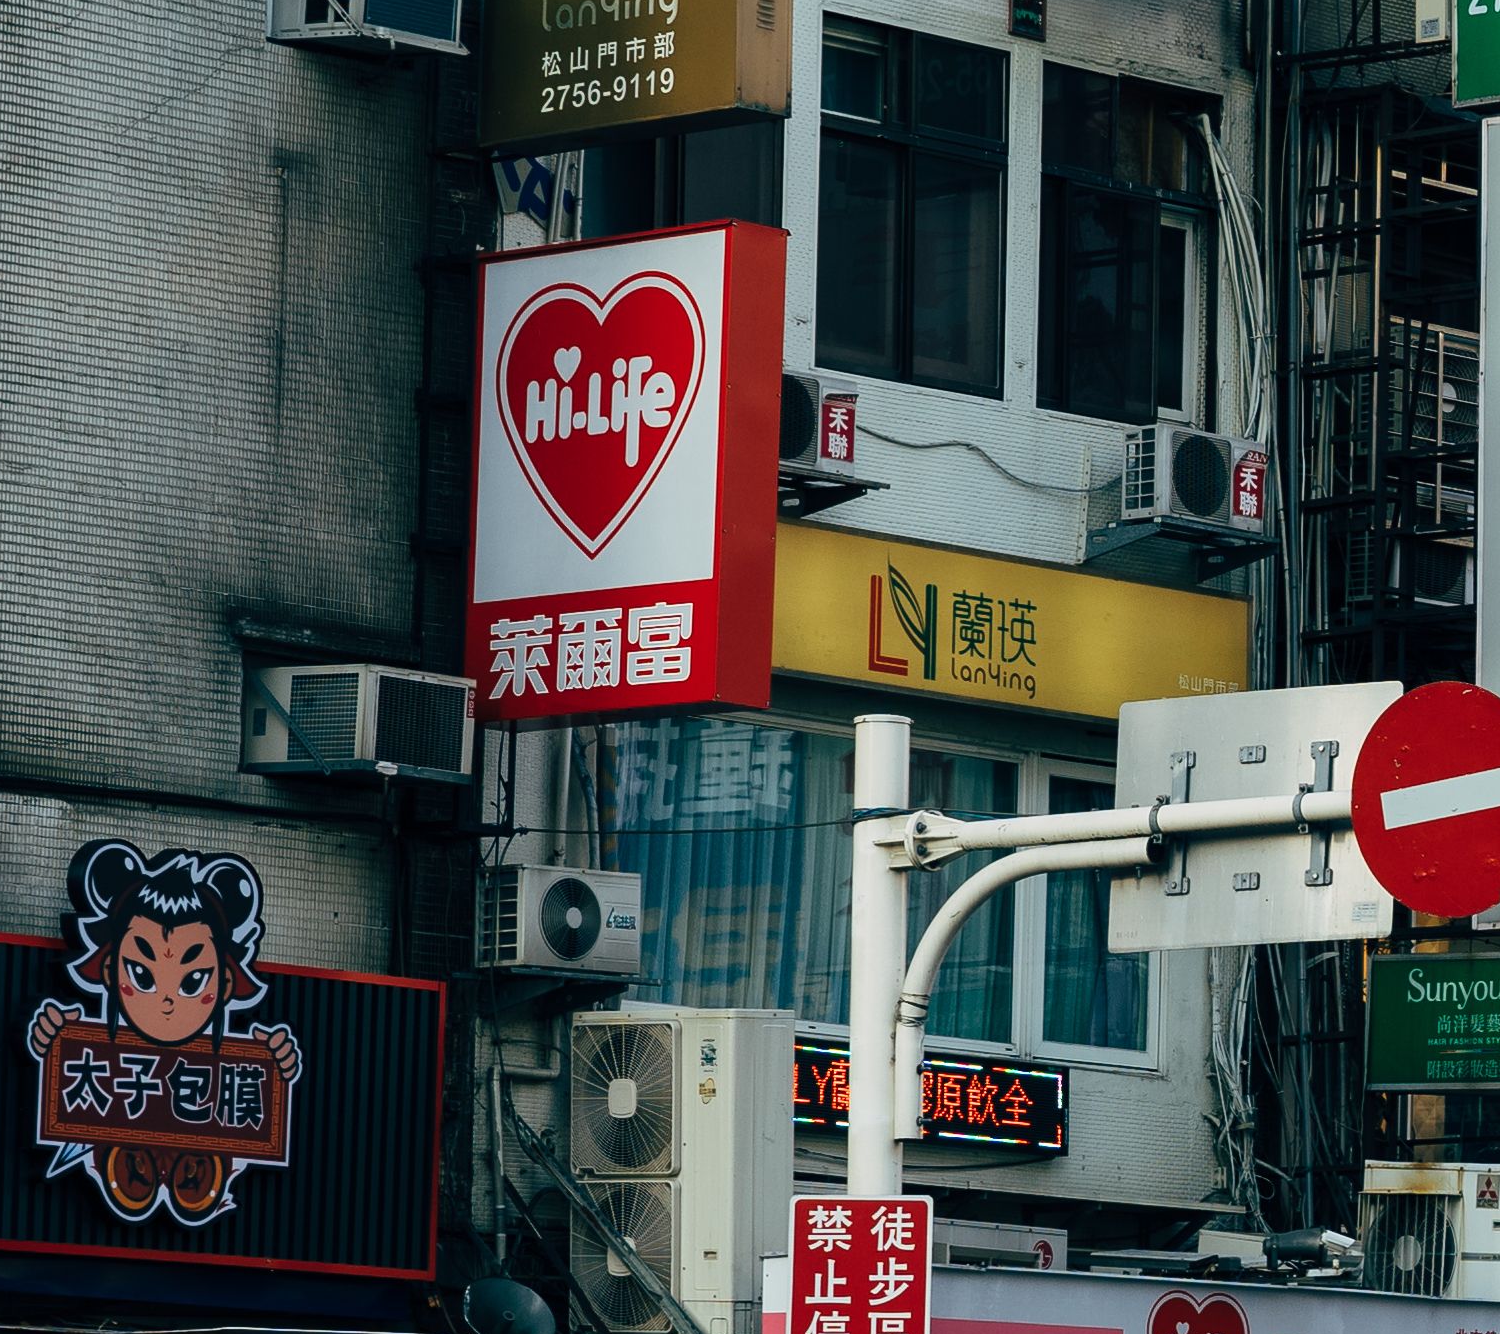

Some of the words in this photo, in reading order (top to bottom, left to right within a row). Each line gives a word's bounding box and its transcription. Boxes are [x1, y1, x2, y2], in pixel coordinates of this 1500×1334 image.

[540, 30, 676, 77] 松山門市部
[540, 66, 675, 114] 2756-9119
[828, 407, 849, 460] 禾聯
[1239, 467, 1258, 517] 禾聯
[488, 601, 695, 703] 萊爾富
[1427, 1037, 1447, 1046] HAIR
[1448, 1037, 1484, 1046] FASHION
[61, 1047, 268, 1133] 太子包膜
